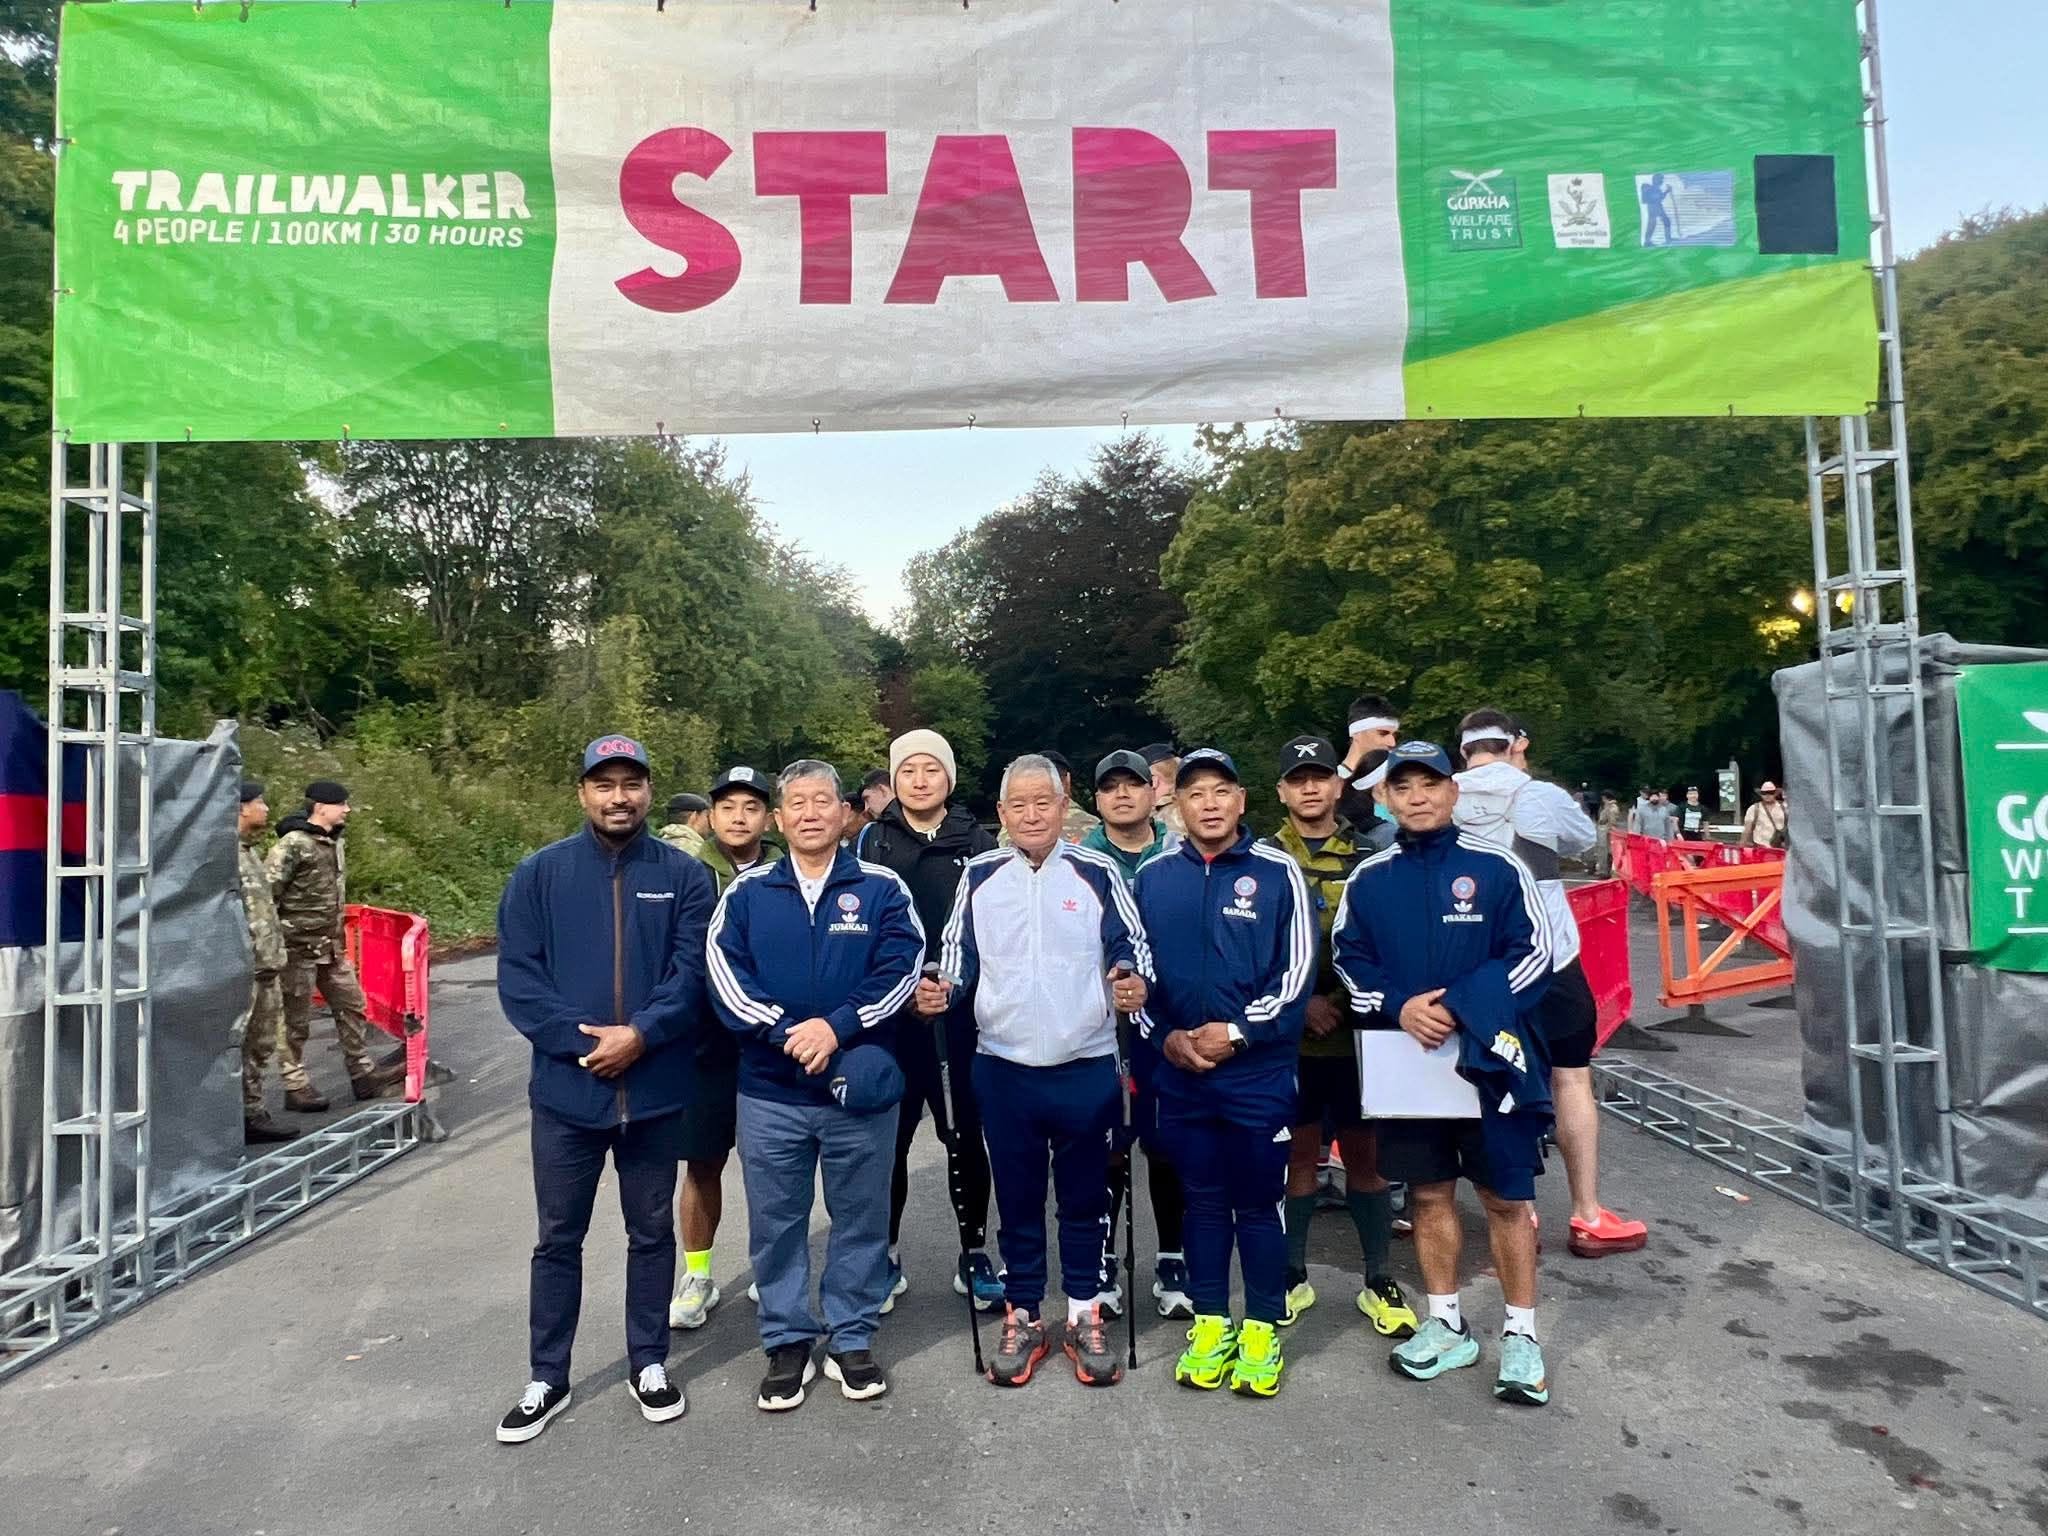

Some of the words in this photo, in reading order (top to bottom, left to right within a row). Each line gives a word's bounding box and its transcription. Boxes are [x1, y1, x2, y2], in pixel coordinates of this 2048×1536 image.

[111, 169, 532, 220] TRAILWALKER
[1447, 195, 1510, 211] GURKHA
[113, 219, 129, 245] 4
[136, 217, 244, 245] PEOPLE
[266, 220, 362, 246] 100KM
[384, 223, 420, 244] 30
[428, 224, 524, 248] HOURS
[614, 126, 1337, 313] START
[1448, 214, 1513, 226] WELFARE
[1451, 227, 1513, 240] TRUST
[2000, 848, 2048, 880] W
